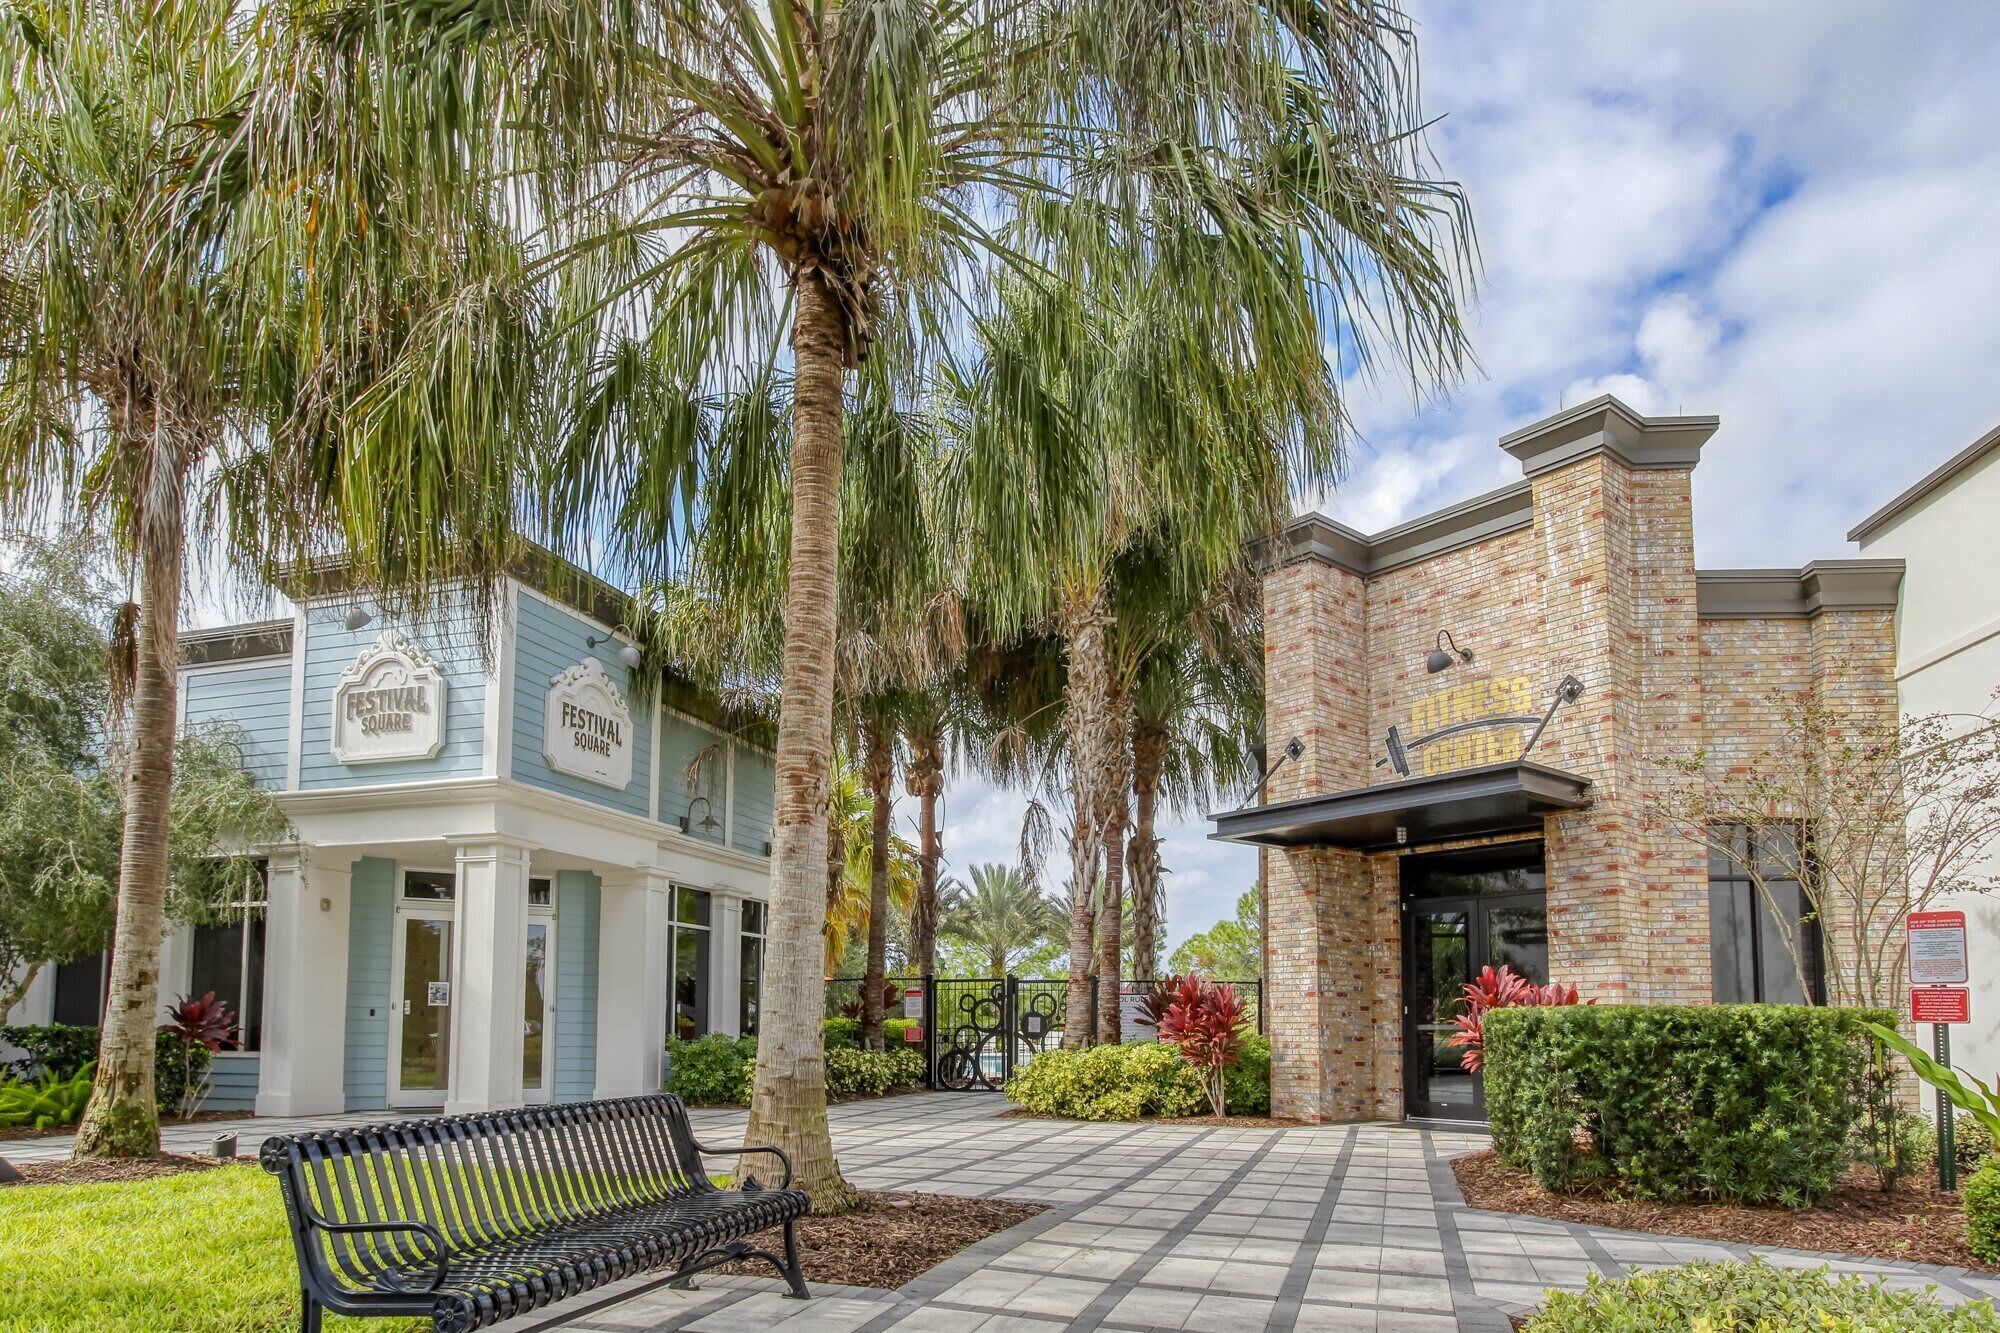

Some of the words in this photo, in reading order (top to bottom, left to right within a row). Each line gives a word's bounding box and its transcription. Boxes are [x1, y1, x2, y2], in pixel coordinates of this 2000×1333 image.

[346, 686, 428, 721] FESTIVAL
[1411, 677, 1531, 737] FITNESS
[361, 713, 413, 737] SQUARE
[562, 702, 622, 747] FESTIVAL
[574, 731, 611, 757] SQUARE
[1423, 731, 1520, 777] CENTER
